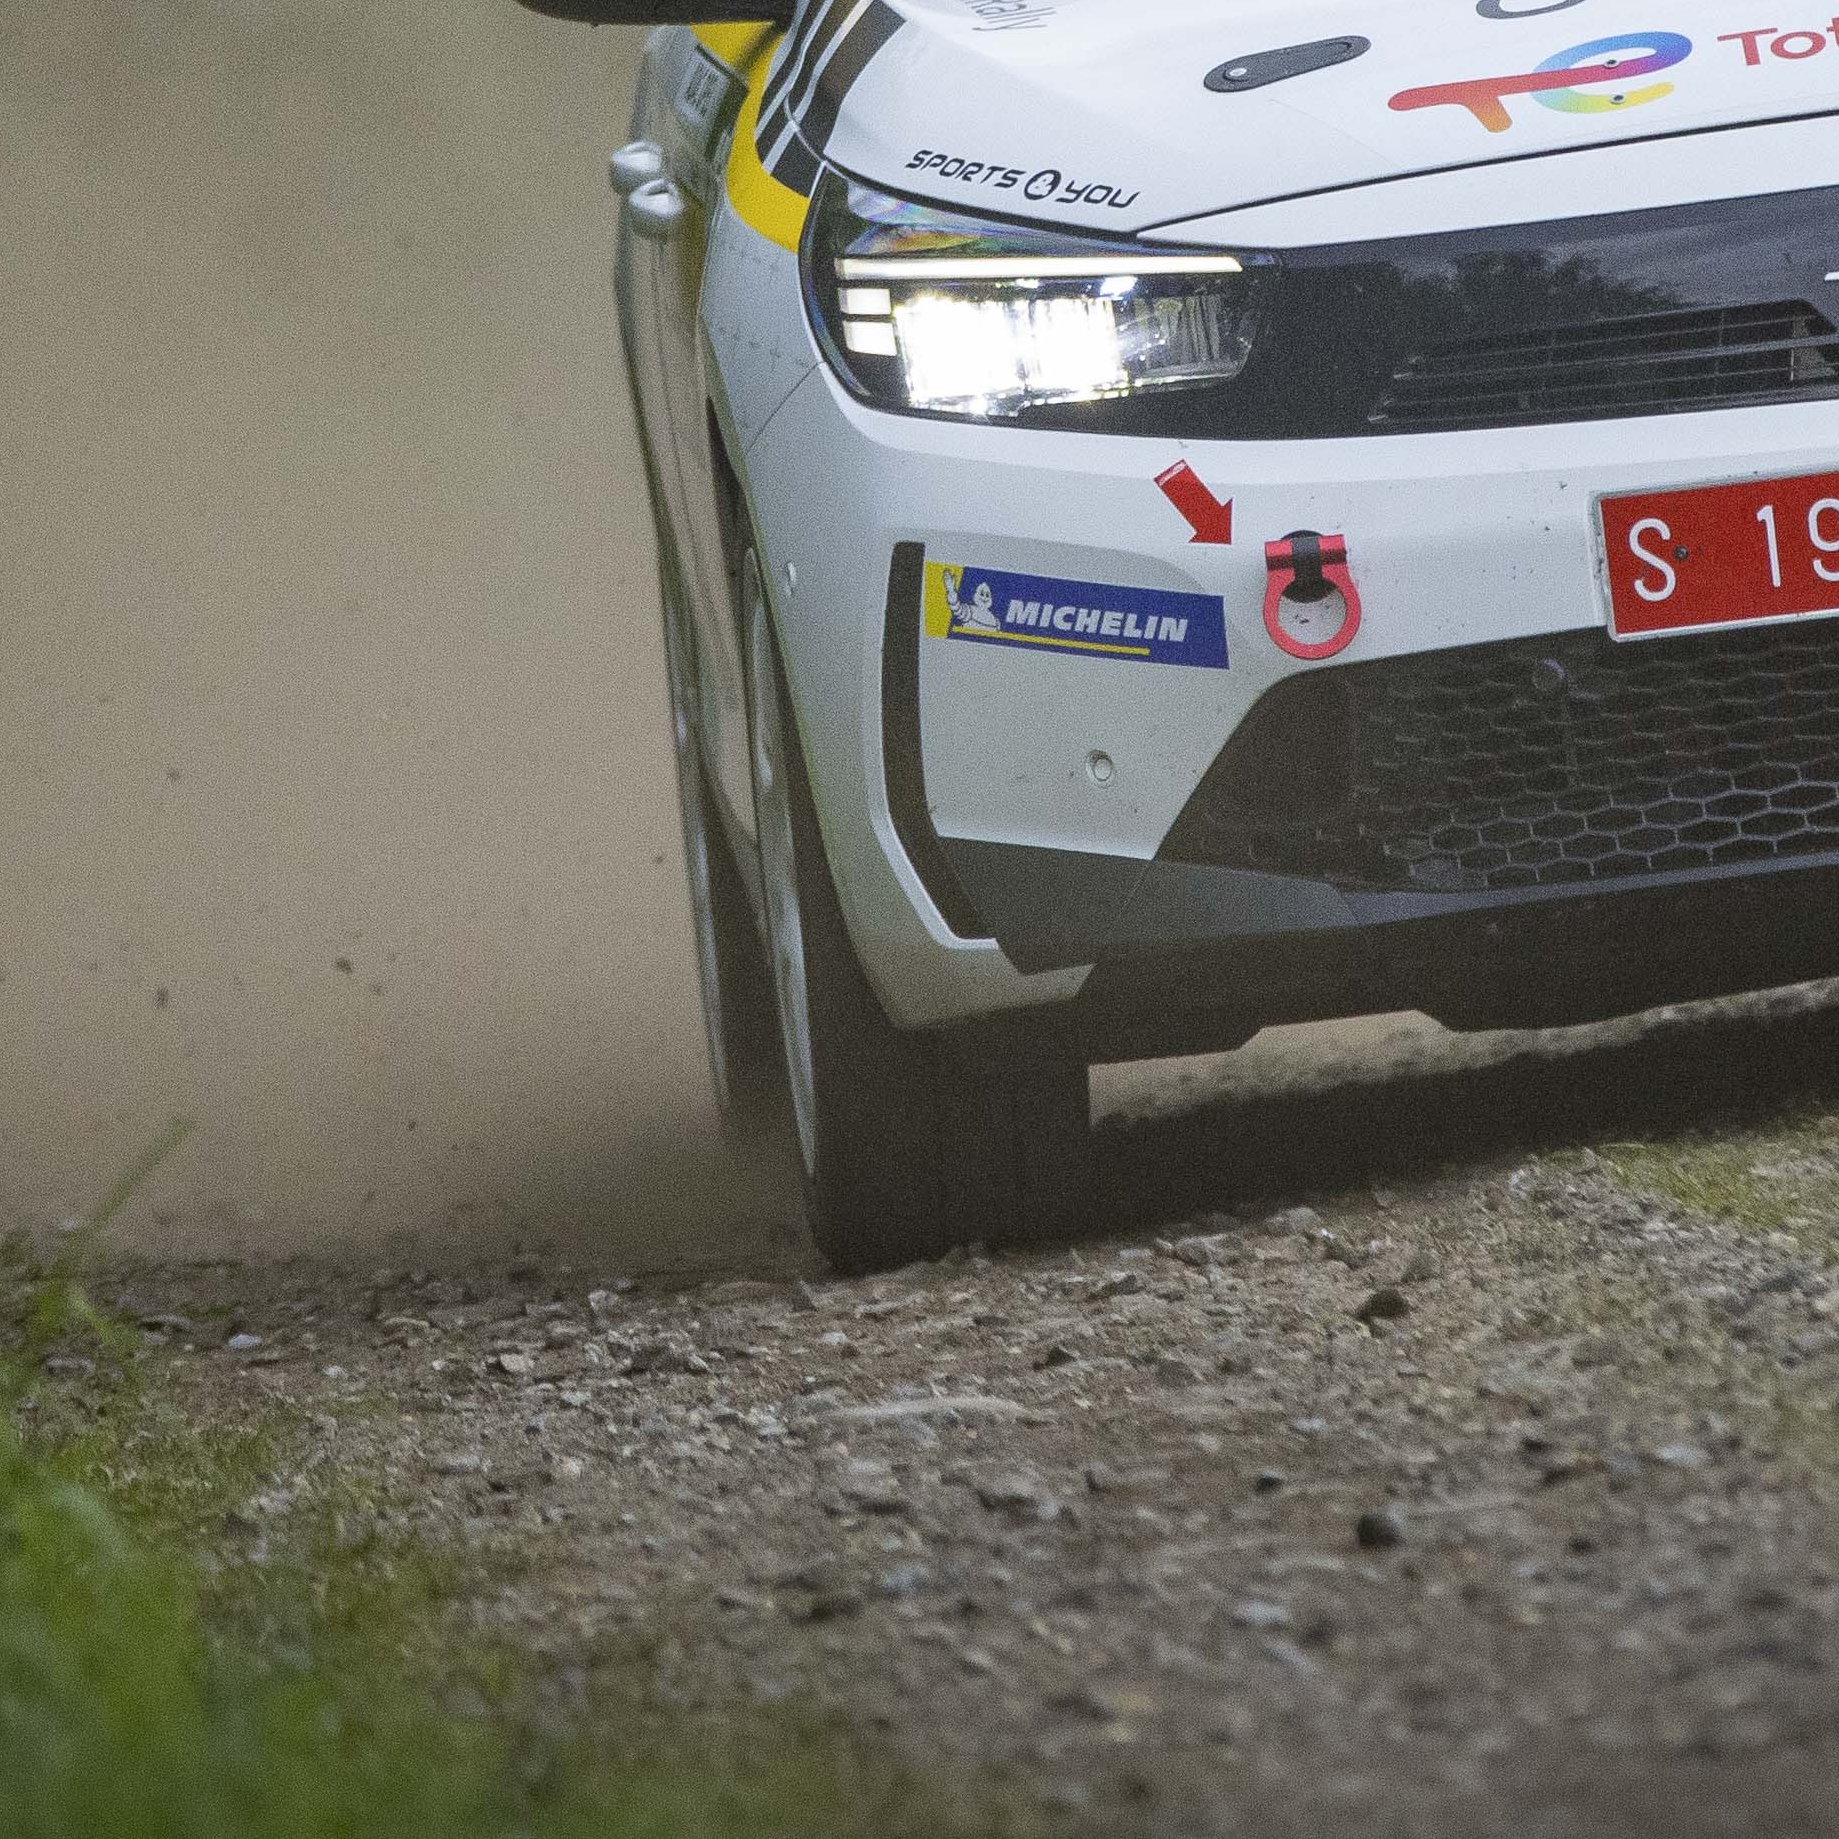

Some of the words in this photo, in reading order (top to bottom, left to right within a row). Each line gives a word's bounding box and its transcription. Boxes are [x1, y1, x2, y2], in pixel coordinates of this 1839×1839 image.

[905, 150, 1027, 188] SPORTS
[1627, 518, 1678, 604] S
[1005, 599, 1189, 644] MICHELIN
